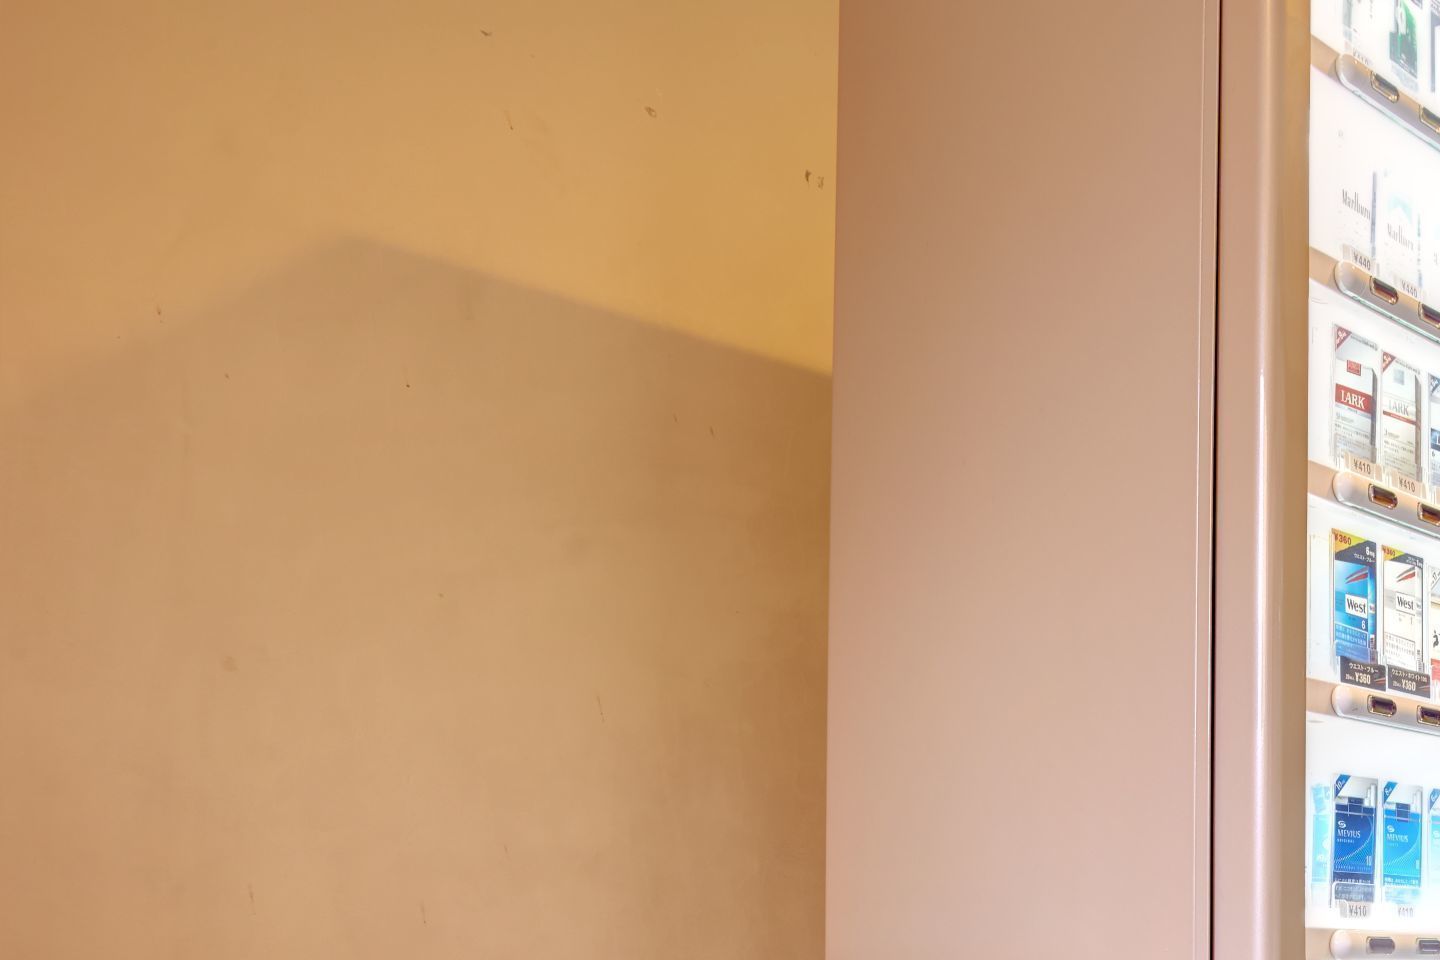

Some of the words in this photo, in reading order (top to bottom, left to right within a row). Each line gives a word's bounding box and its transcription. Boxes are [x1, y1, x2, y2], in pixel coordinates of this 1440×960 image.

[1341, 389, 1365, 410] LARK
[1388, 399, 1410, 417] LARK
[1353, 459, 1371, 475] ¥410
[1399, 478, 1415, 493] ¥410
[1346, 597, 1367, 614] West
[1396, 596, 1414, 611] West
[1361, 620, 1366, 630] 6
[1348, 662, 1379, 674] ウエスト・ブルー
[1355, 672, 1371, 685] ¥360
[1401, 679, 1416, 691] ¥360
[1337, 829, 1361, 839] MEVIUS
[1386, 833, 1409, 843] MEVIUS
[1350, 905, 1367, 918] ¥410
